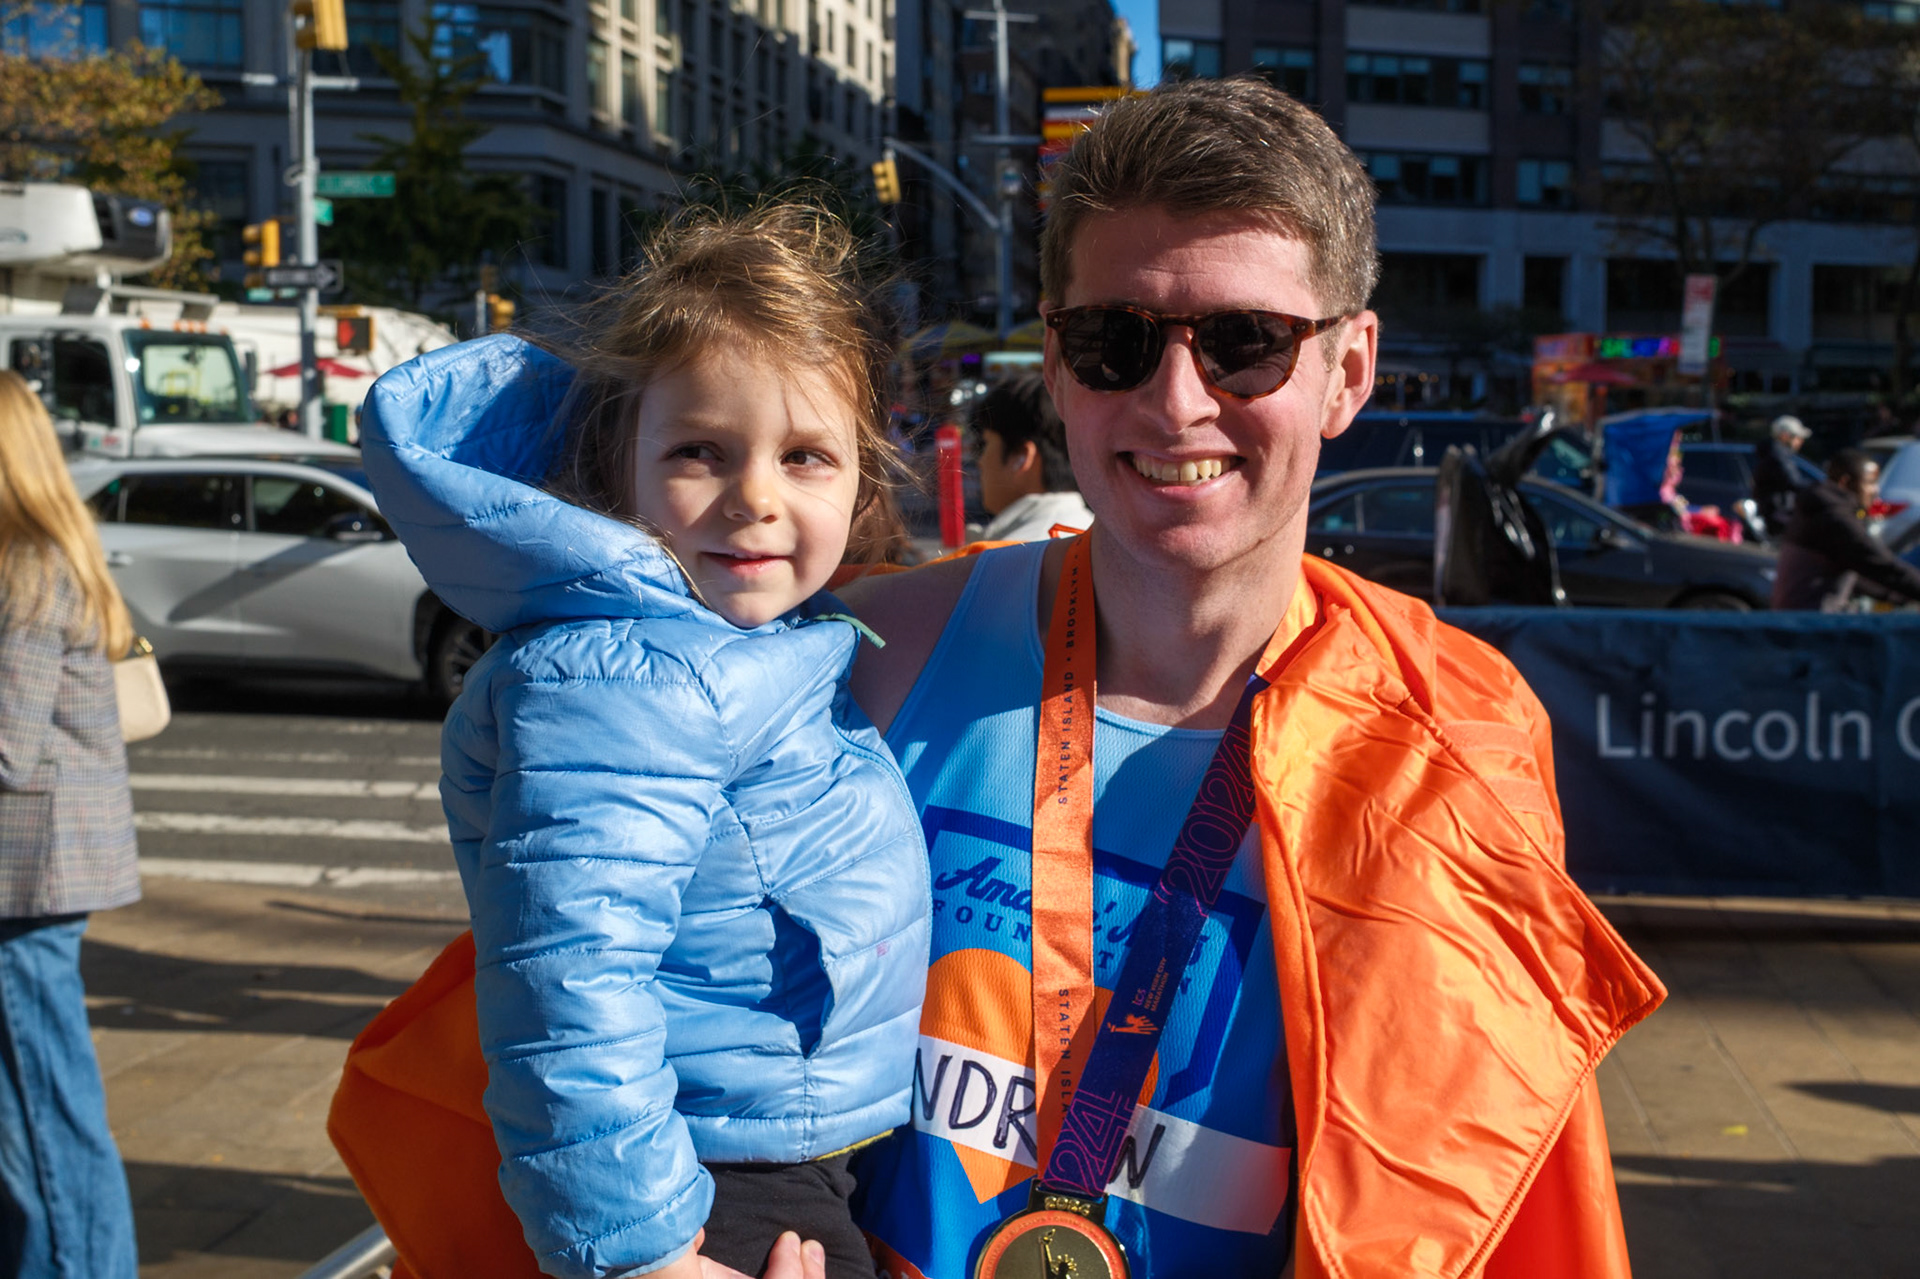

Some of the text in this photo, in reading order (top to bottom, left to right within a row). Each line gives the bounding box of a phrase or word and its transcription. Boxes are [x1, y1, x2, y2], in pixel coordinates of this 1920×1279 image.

[1058, 567, 1078, 804] STATEN ISLAND BROOKLYN
[1596, 691, 1872, 761] Lincoln
[1153, 723, 1256, 918] 2024
[1150, 972, 1169, 1012] MARATHON
[1157, 956, 1167, 973] CITY
[1058, 988, 1072, 1121] STATEN ISLA
[1040, 1088, 1136, 1198] 24
